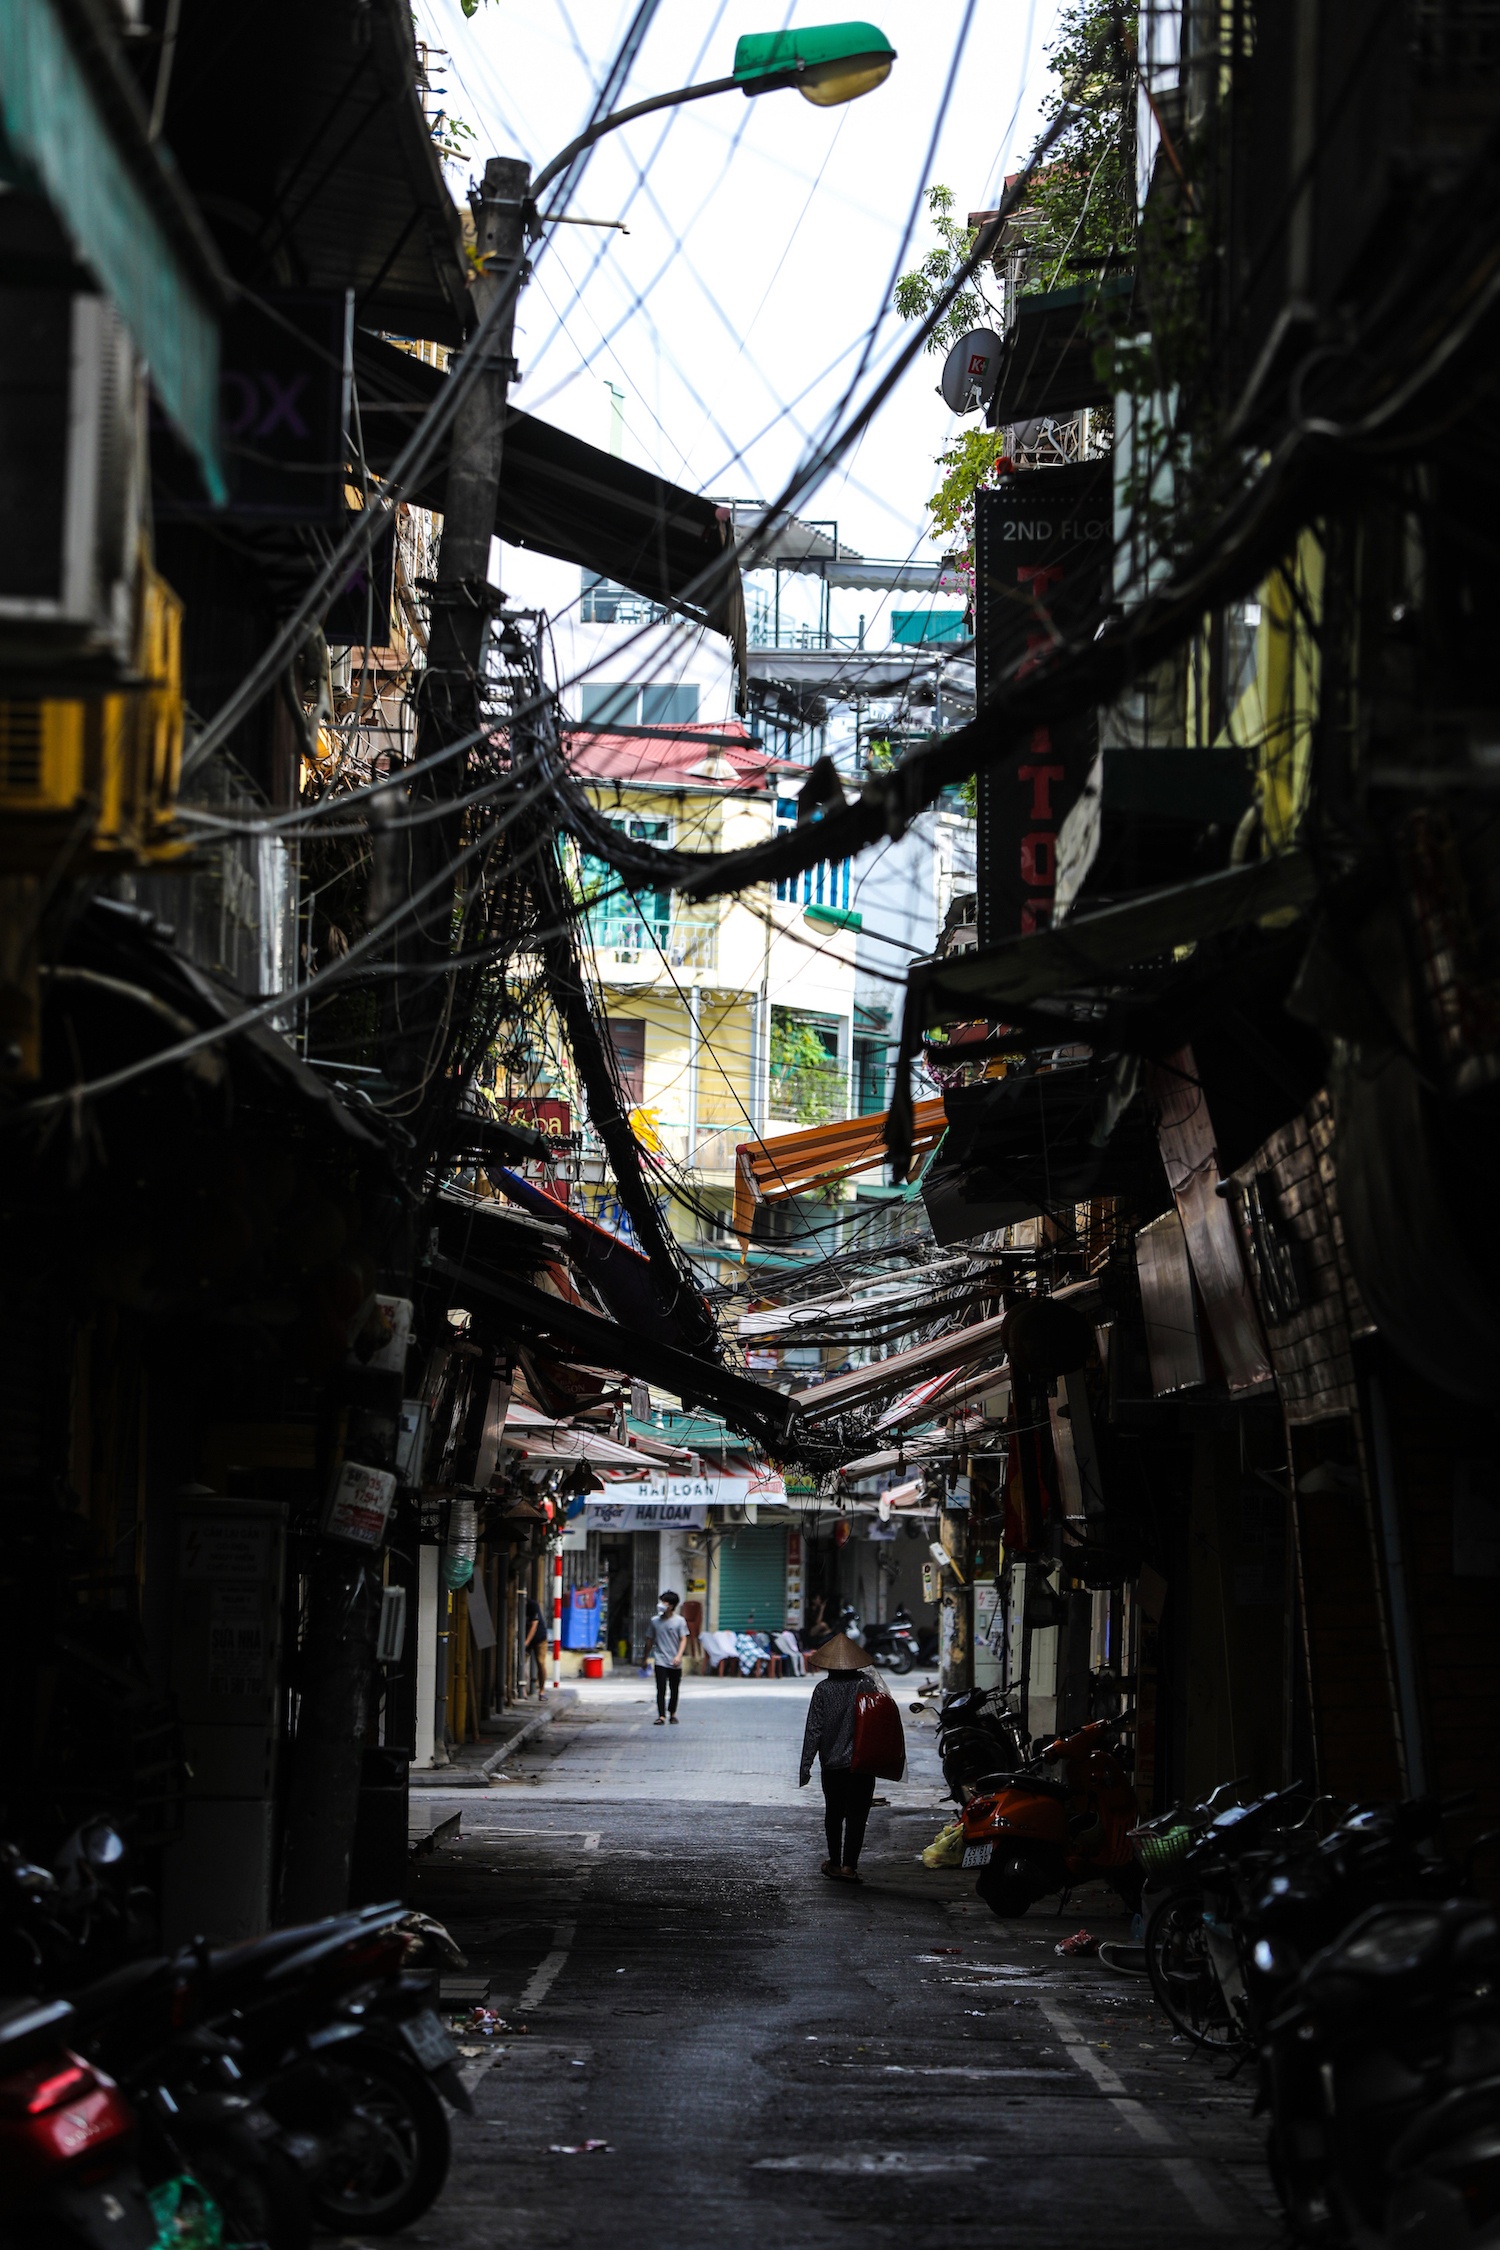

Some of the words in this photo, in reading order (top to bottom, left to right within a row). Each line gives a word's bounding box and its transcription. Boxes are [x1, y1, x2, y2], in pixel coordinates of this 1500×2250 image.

[220, 370, 312, 438] OX
[1003, 521, 1053, 541] 2ND
[595, 1504, 625, 1522] Tiger
[660, 1506, 692, 1520] LOAN
